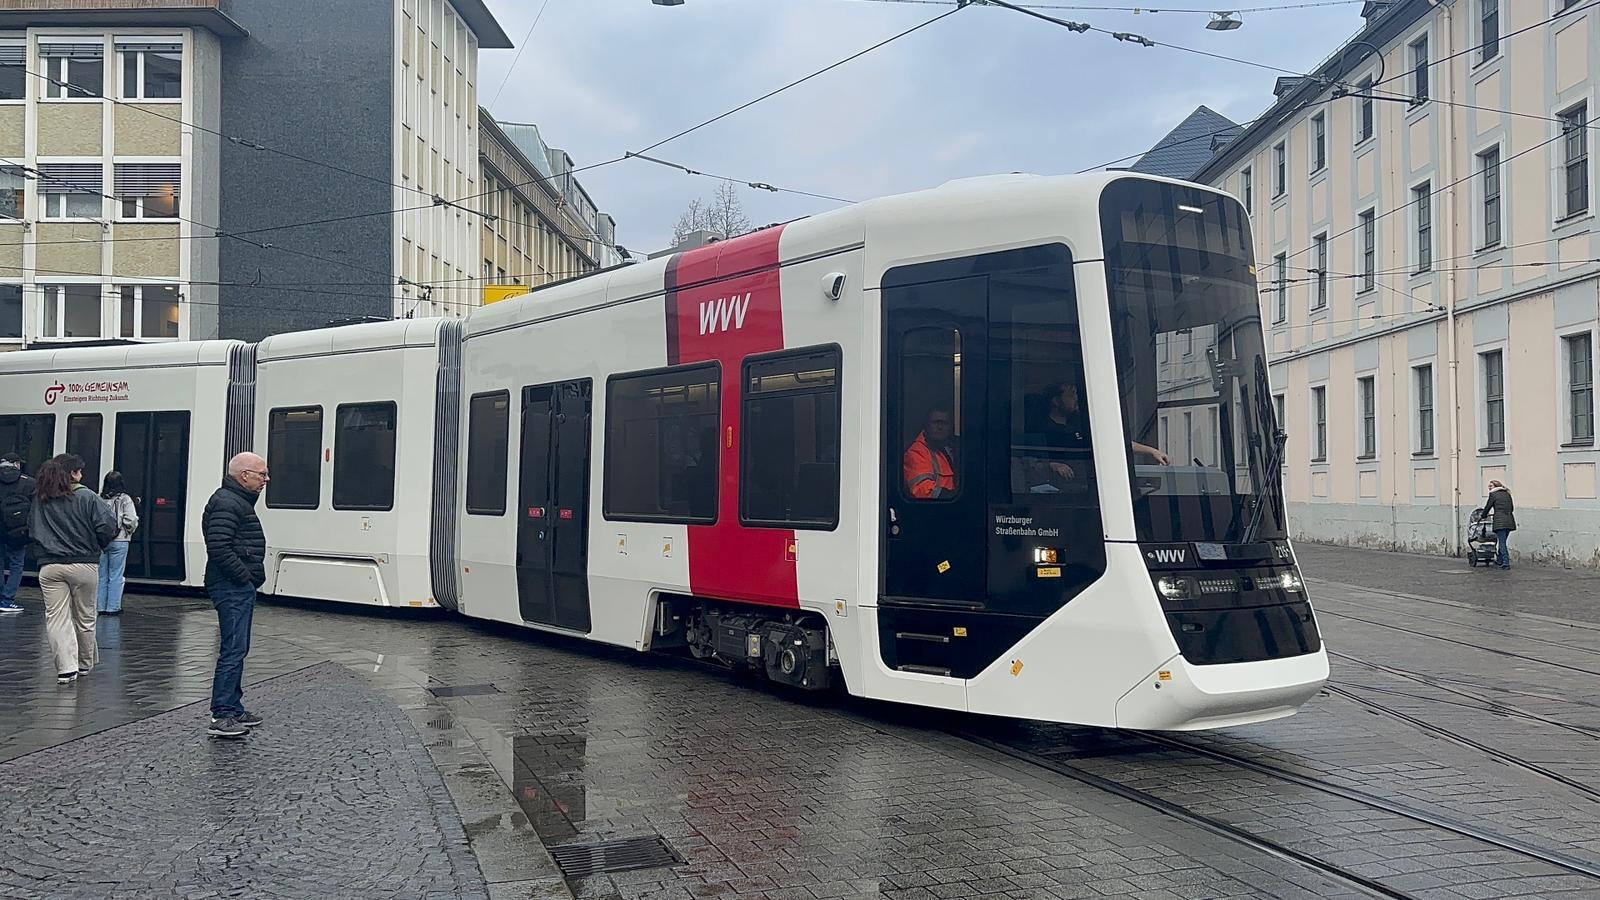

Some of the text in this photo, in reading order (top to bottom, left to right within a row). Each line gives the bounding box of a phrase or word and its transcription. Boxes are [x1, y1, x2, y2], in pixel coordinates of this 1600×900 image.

[699, 292, 752, 336] WVV
[68, 383, 84, 392] 100%
[995, 515, 1033, 526] Würzburger
[995, 526, 1060, 537] Straßenbahn GmbH
[1155, 549, 1185, 563] WVV
